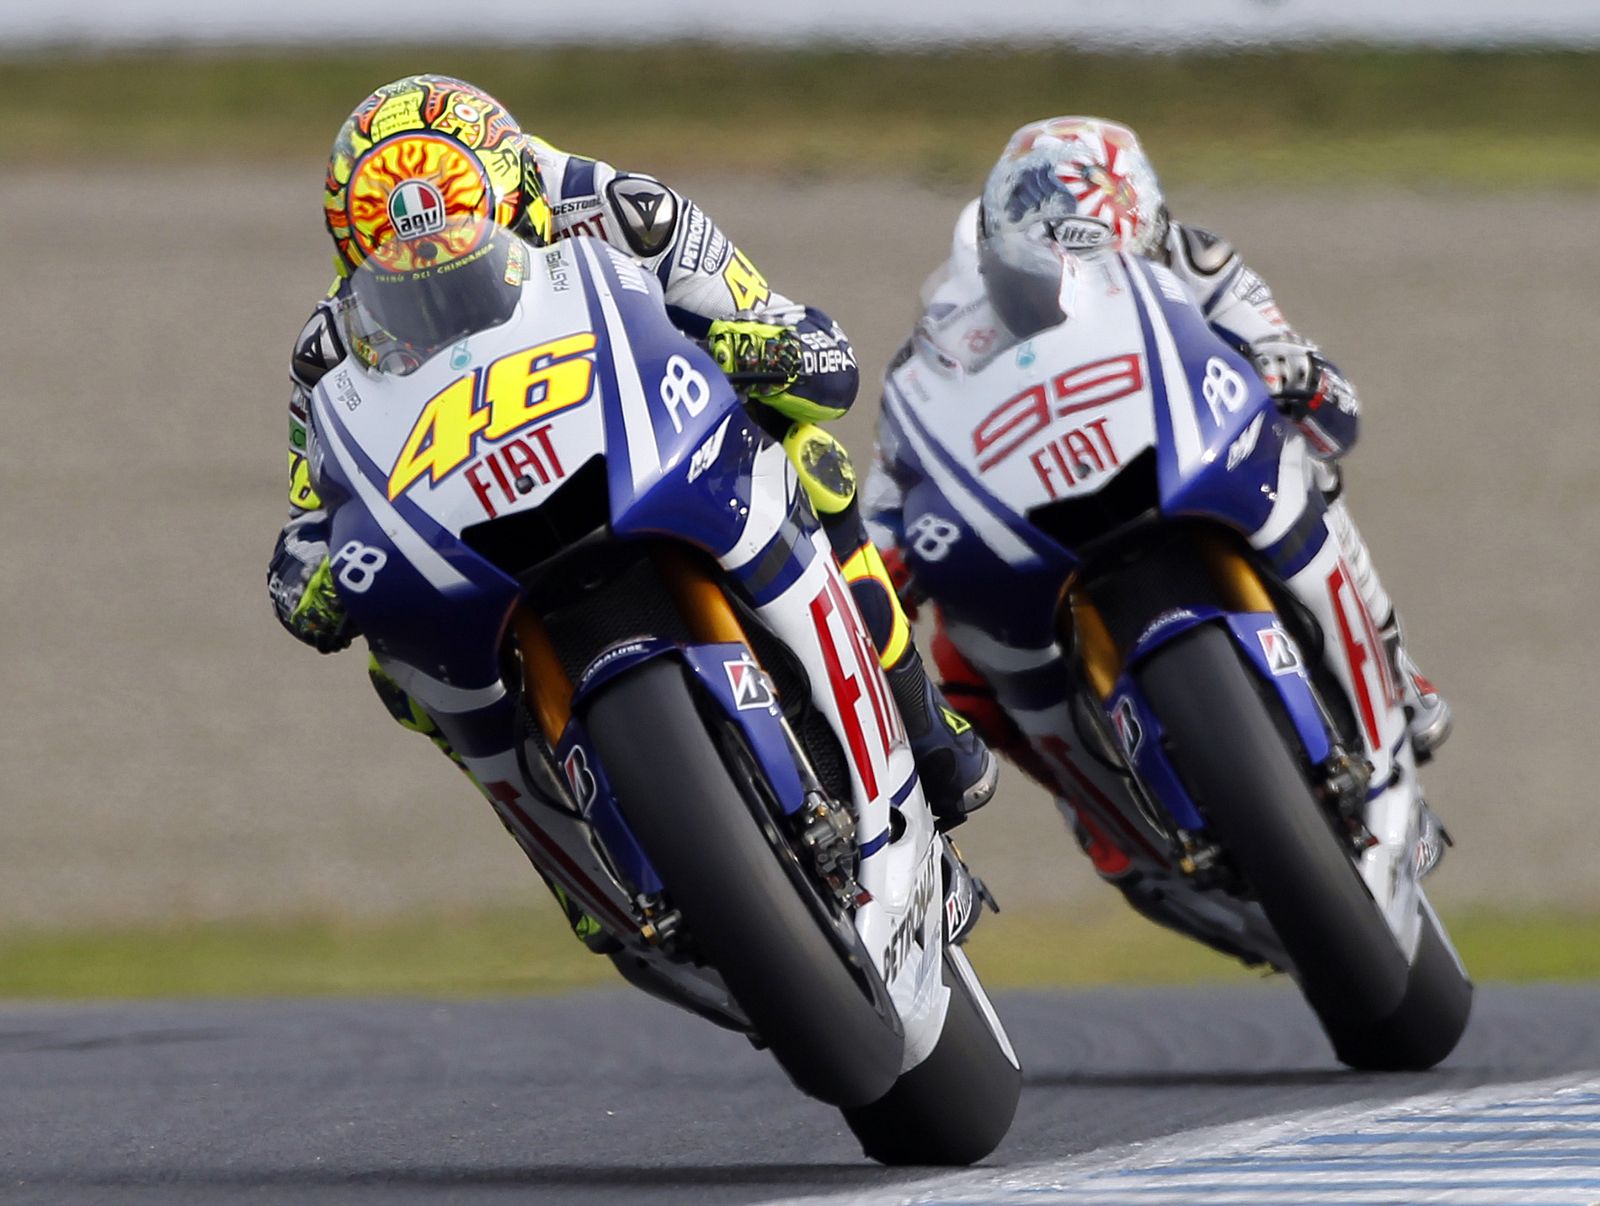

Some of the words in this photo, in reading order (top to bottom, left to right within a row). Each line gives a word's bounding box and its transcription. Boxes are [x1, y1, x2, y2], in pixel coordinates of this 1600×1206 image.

[722, 245, 771, 311] 4
[387, 331, 598, 502] 46
[972, 352, 1144, 474] 99
[1029, 416, 1121, 501] FIAT
[463, 424, 565, 520] FIAT
